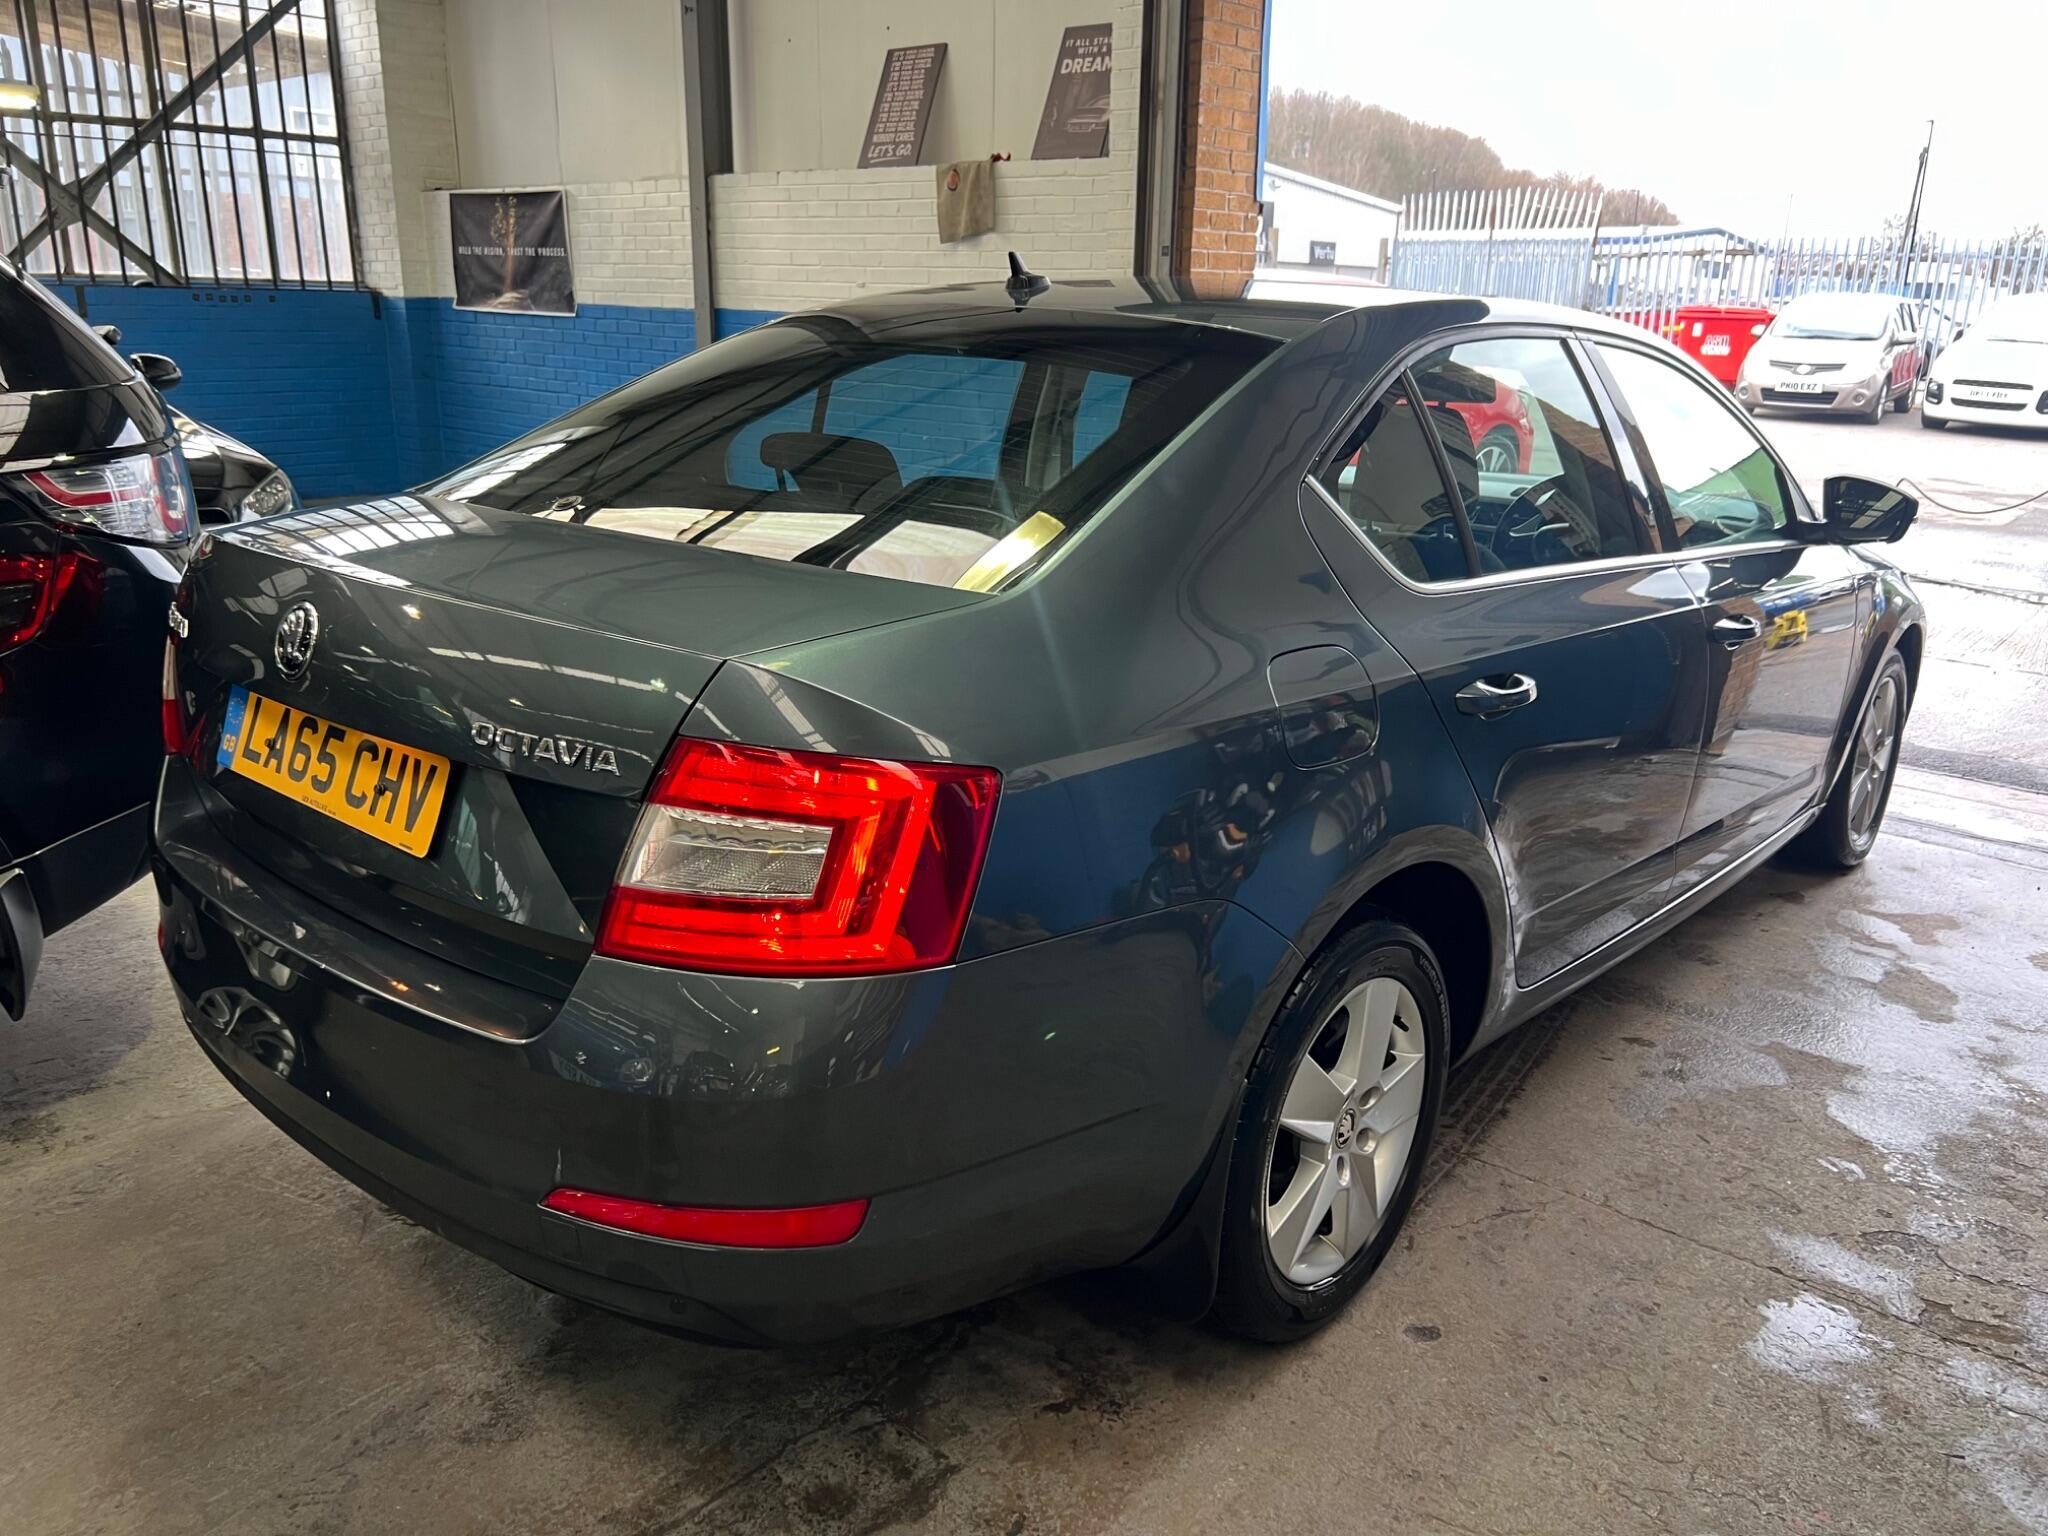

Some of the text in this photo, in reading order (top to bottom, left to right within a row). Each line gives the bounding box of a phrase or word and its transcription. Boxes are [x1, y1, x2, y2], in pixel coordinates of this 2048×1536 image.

[1065, 37, 1110, 47] IT ALL STA
[1078, 46, 1099, 54] WITH
[868, 144, 896, 158] LET'S
[222, 733, 237, 754] GB
[471, 721, 621, 777] OCTAVIA
[242, 696, 438, 833] LA65 CHV
